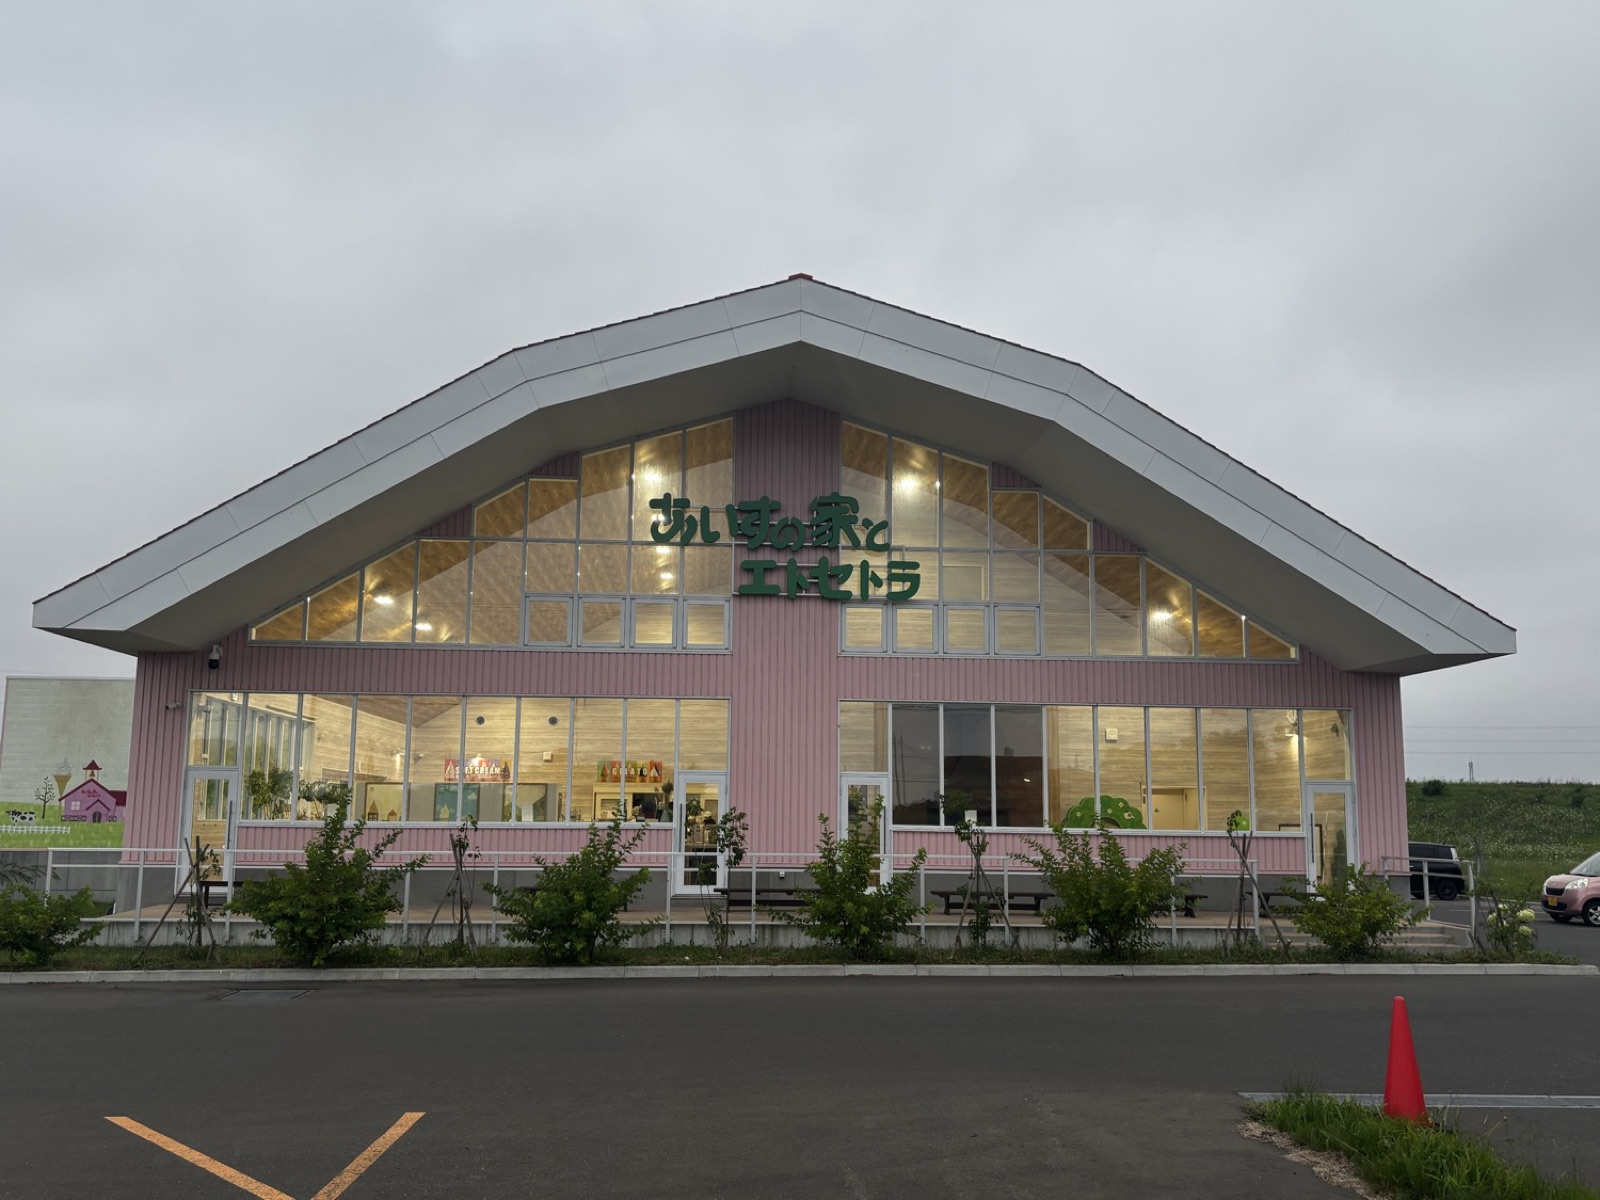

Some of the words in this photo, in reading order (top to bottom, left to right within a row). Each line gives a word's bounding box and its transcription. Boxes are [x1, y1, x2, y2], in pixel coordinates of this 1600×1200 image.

[649, 492, 891, 552] あいすの家と
[738, 556, 921, 601] エトセトラ
